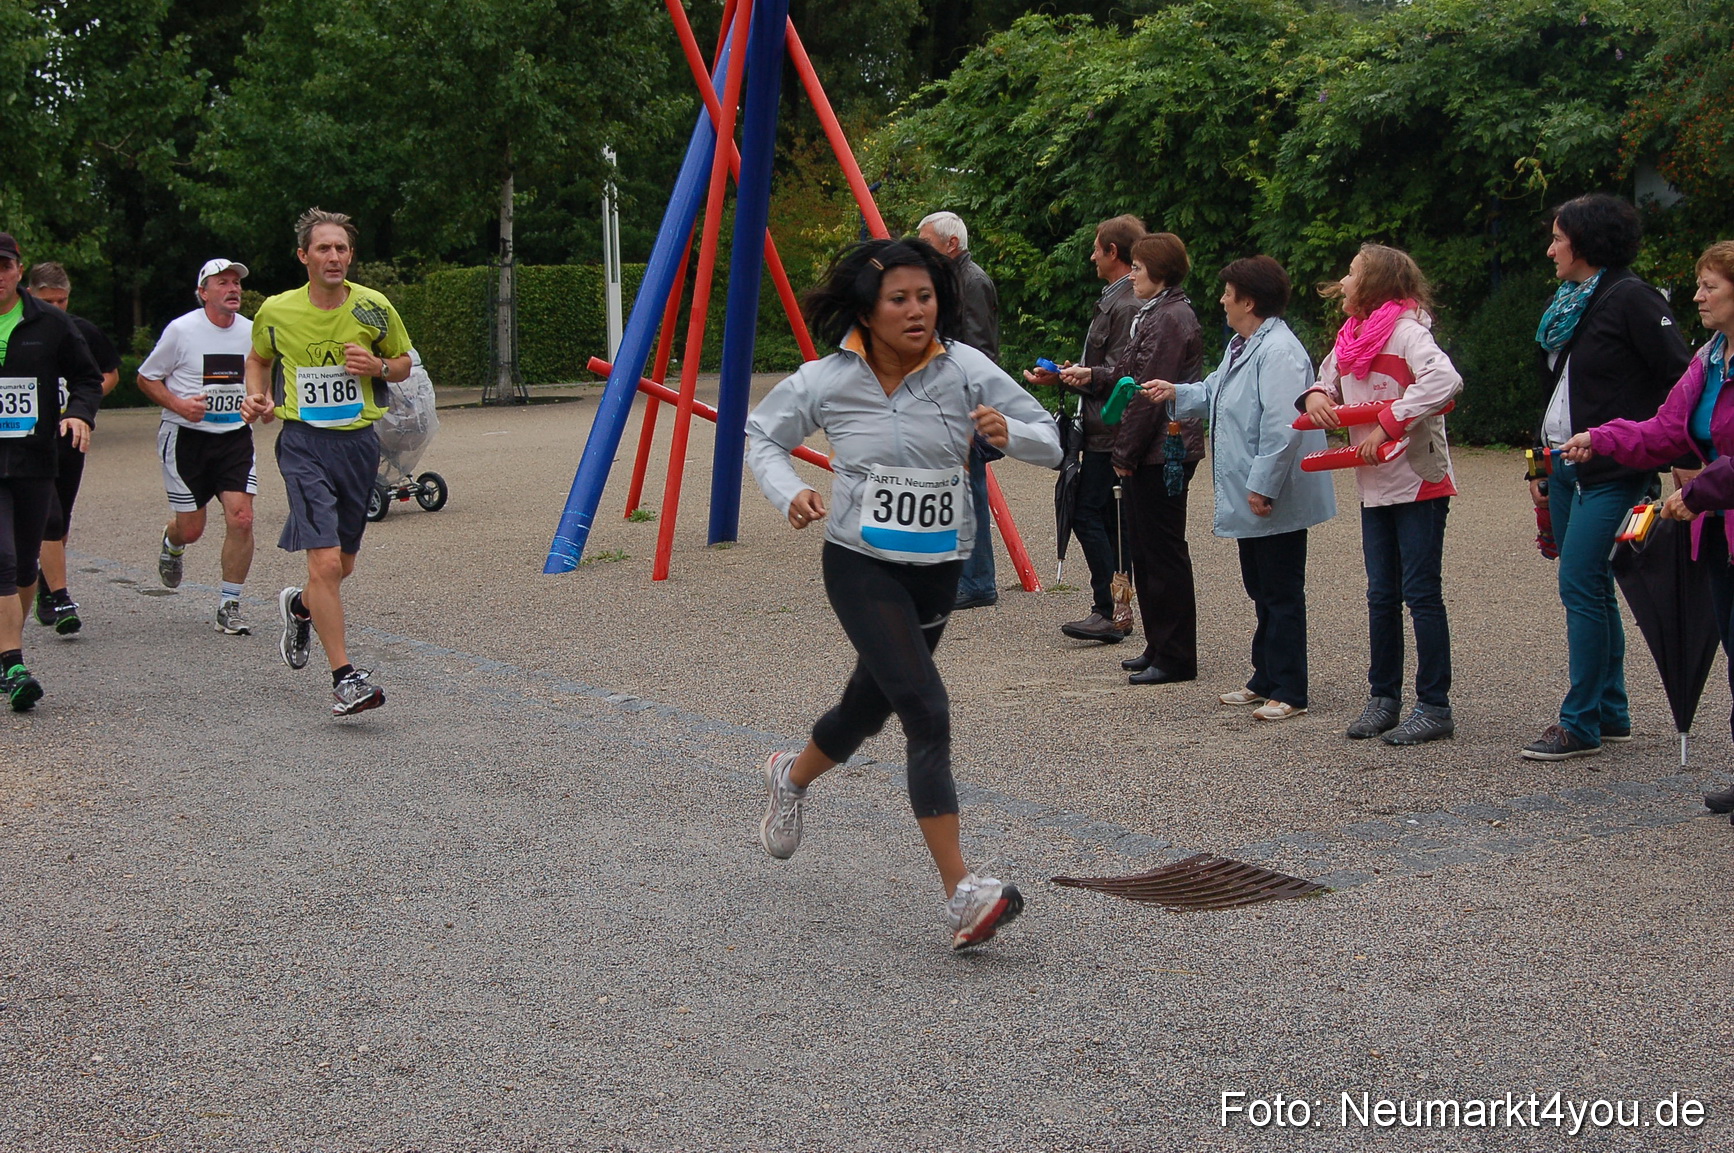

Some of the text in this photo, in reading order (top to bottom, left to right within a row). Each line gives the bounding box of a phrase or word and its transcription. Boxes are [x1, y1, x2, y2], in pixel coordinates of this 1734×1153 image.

[303, 379, 357, 404] 3186
[206, 395, 244, 412] 3036
[869, 472, 950, 489] PARTL Neumarkt
[873, 489, 954, 528] 3068
